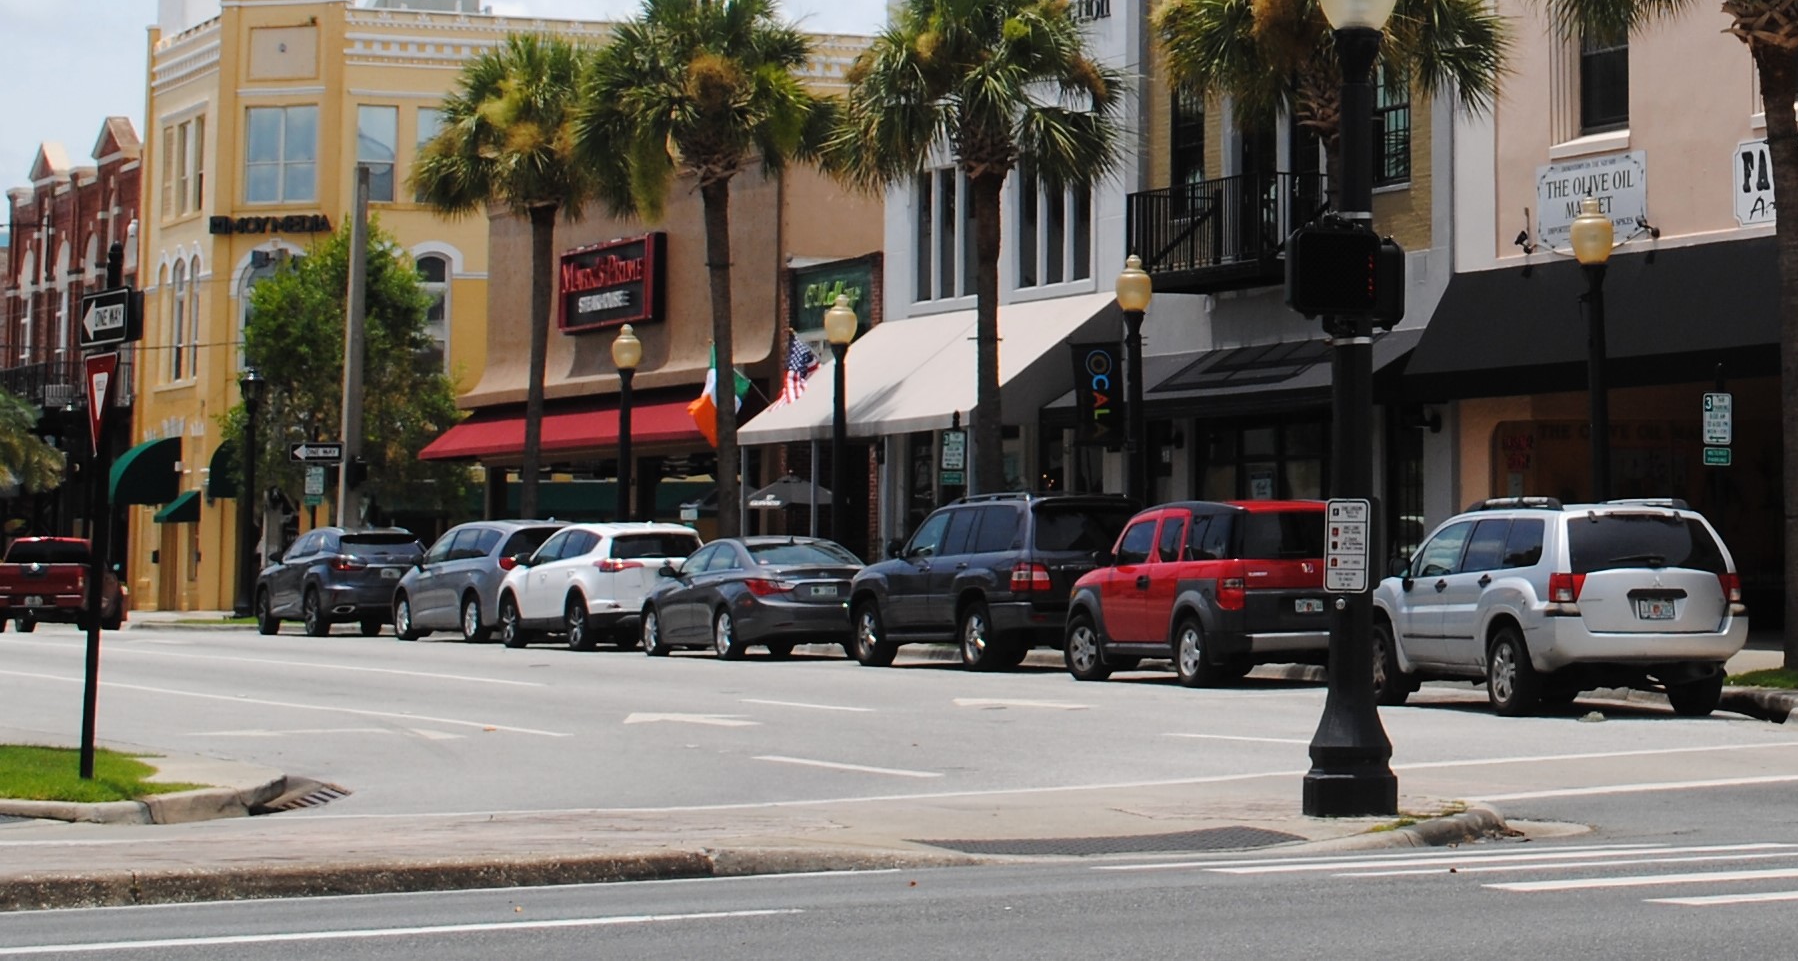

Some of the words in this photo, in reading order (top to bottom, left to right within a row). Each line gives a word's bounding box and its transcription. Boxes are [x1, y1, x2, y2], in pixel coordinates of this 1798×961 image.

[1546, 179, 1570, 199] THE
[1573, 173, 1609, 196] OLIVE
[1613, 170, 1634, 190] OIL
[1565, 196, 1613, 219] MAET
[95, 309, 108, 327] ONE
[109, 307, 122, 325] WAY
[1705, 397, 1711, 409] 3
